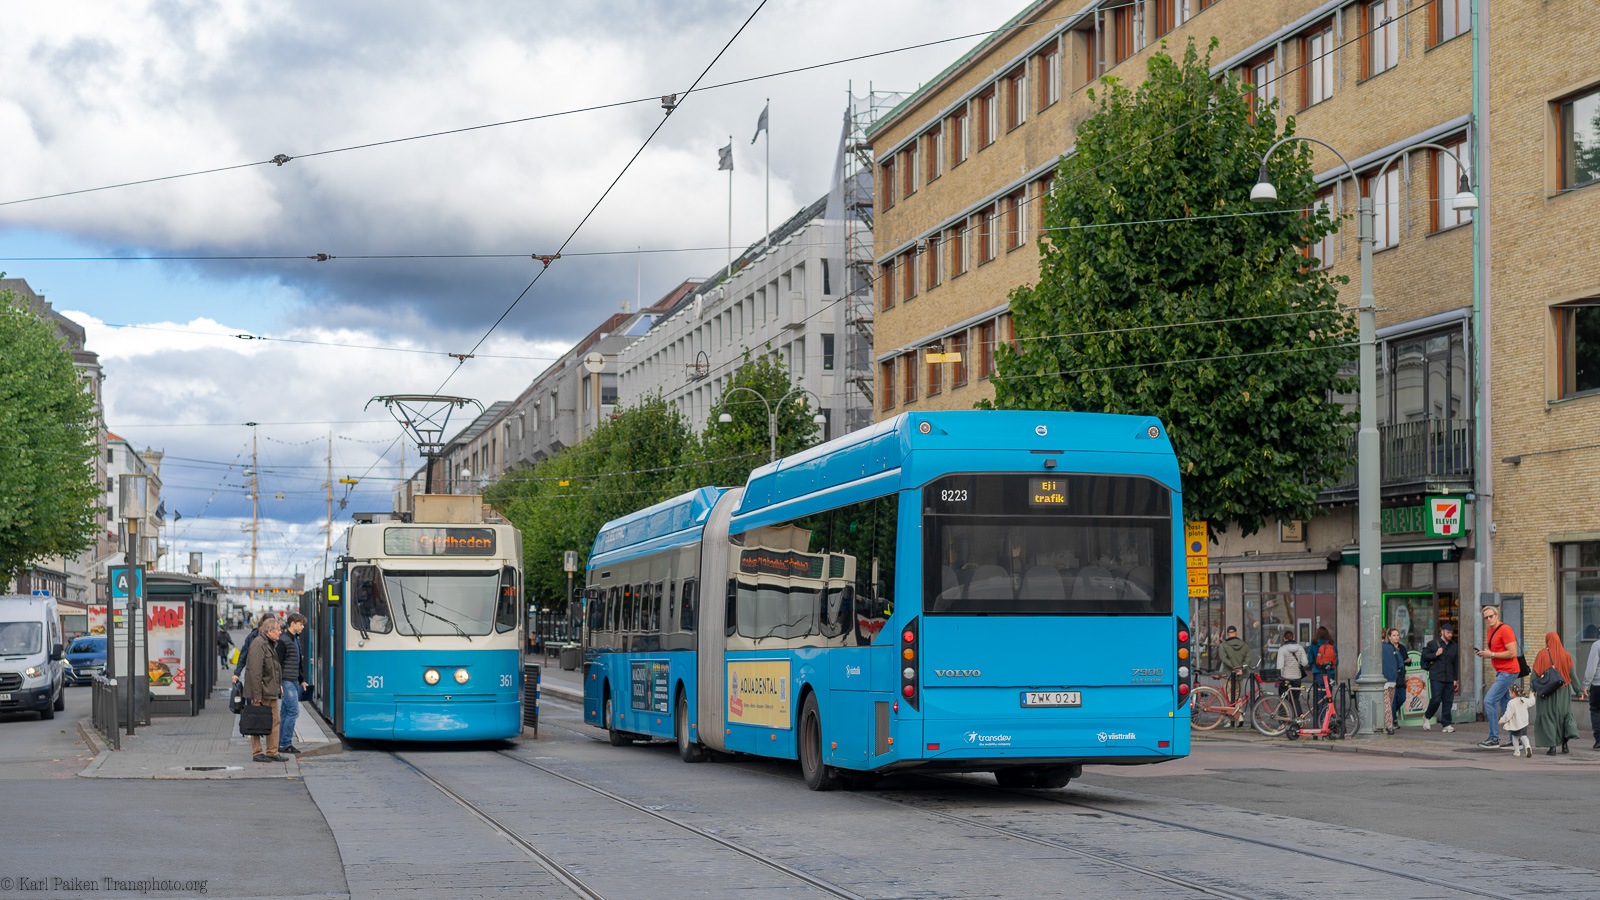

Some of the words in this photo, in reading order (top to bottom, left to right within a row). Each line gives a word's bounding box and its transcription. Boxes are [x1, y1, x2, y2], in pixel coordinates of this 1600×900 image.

[1042, 481, 1051, 491] Ej
[941, 490, 968, 501] 8223
[1035, 494, 1064, 503] trafik
[1436, 504, 1457, 534] 7
[420, 536, 492, 548] Guldheden
[118, 576, 128, 588] A
[934, 669, 982, 678] VOLVO
[1132, 668, 1164, 676] 7900
[366, 675, 384, 689] 361
[499, 674, 513, 687] 361
[740, 677, 777, 695] AQUADENTAL
[1031, 693, 1051, 703] ZWK
[1055, 693, 1076, 703] 02J
[978, 734, 1012, 742] transdev
[1108, 732, 1136, 740] västtrafik
